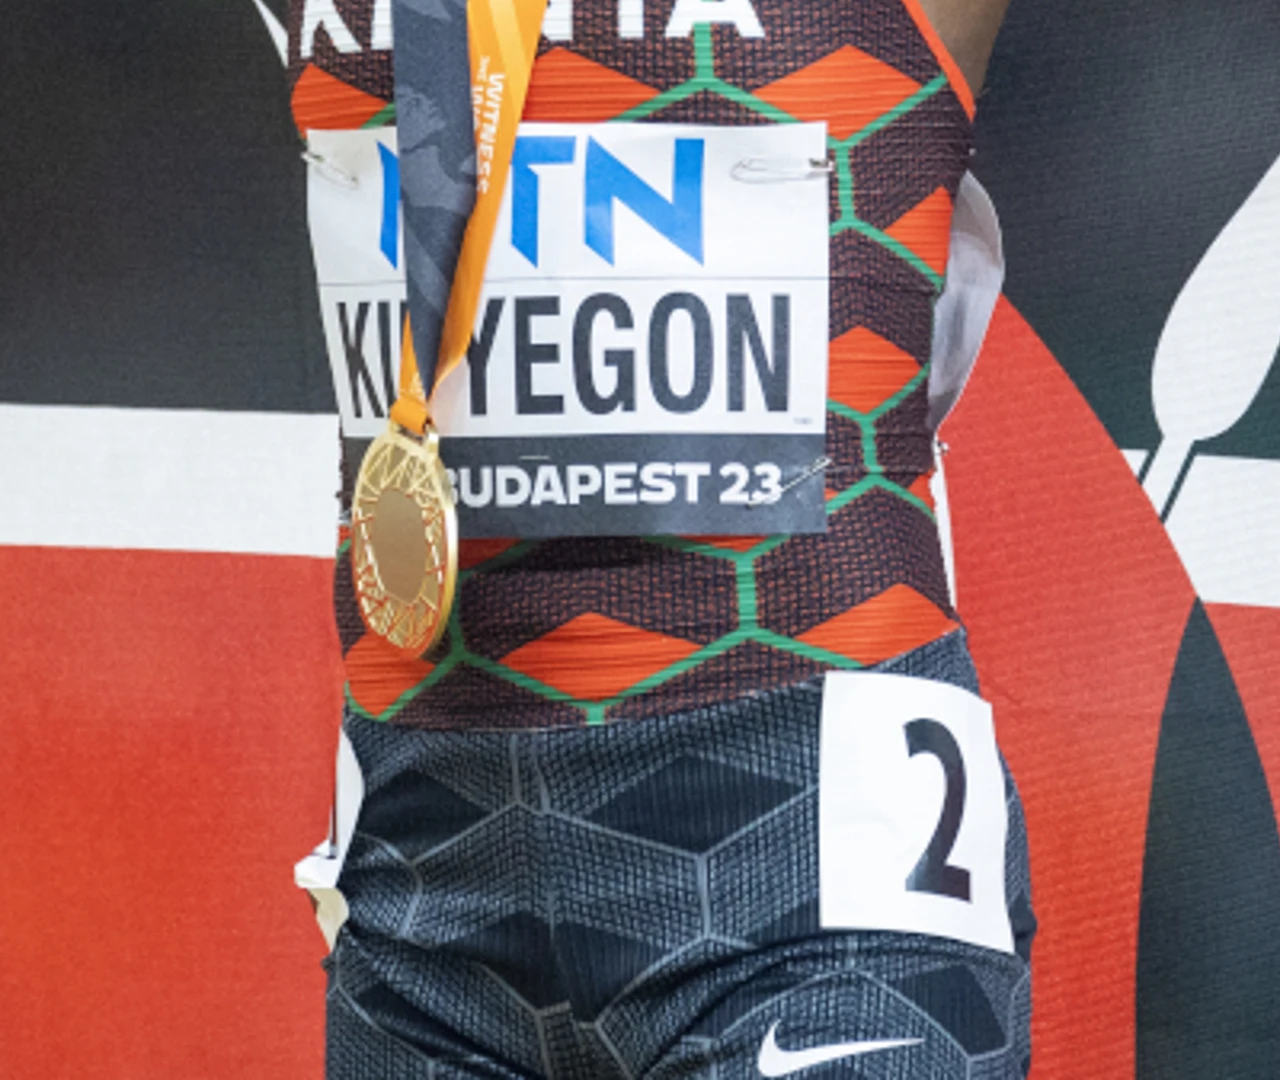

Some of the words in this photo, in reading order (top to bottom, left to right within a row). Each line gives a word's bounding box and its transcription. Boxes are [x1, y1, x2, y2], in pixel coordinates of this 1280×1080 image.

[335, 291, 791, 419] KIYEGON
[719, 461, 784, 506] 23
[903, 718, 972, 904] 2
